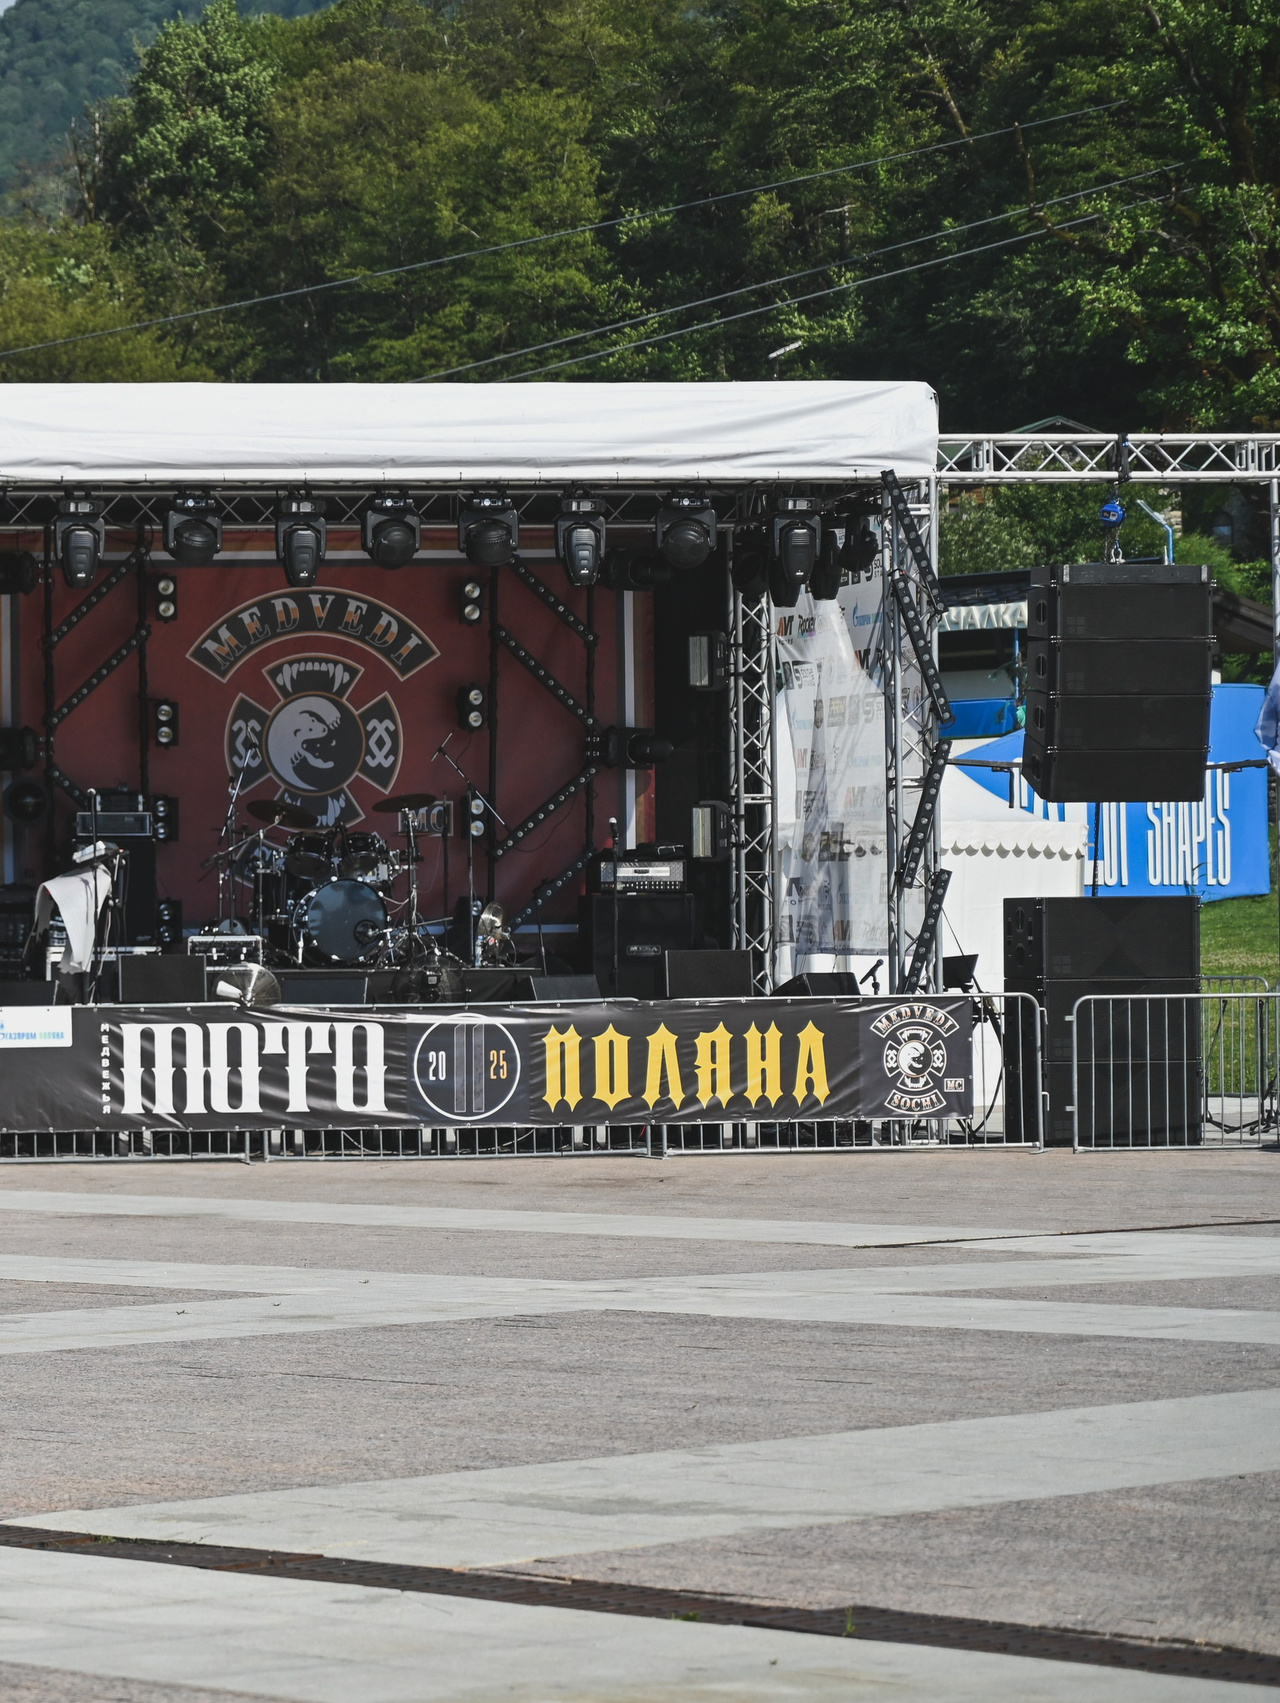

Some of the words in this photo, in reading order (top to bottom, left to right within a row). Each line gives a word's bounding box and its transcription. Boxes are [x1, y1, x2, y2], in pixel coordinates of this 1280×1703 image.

[201, 594, 422, 670] MEDVEDI
[875, 1005, 954, 1033] MEDVEDI
[100, 1023, 111, 1114] МЕДВЕЖЬЯ
[120, 1022, 389, 1115] МОТО
[428, 1051, 446, 1080] 20
[489, 1050, 507, 1079] 25
[541, 1019, 832, 1113] ПОЛЯНА
[946, 1080, 963, 1091] MC
[890, 1094, 940, 1112] SOCHI
